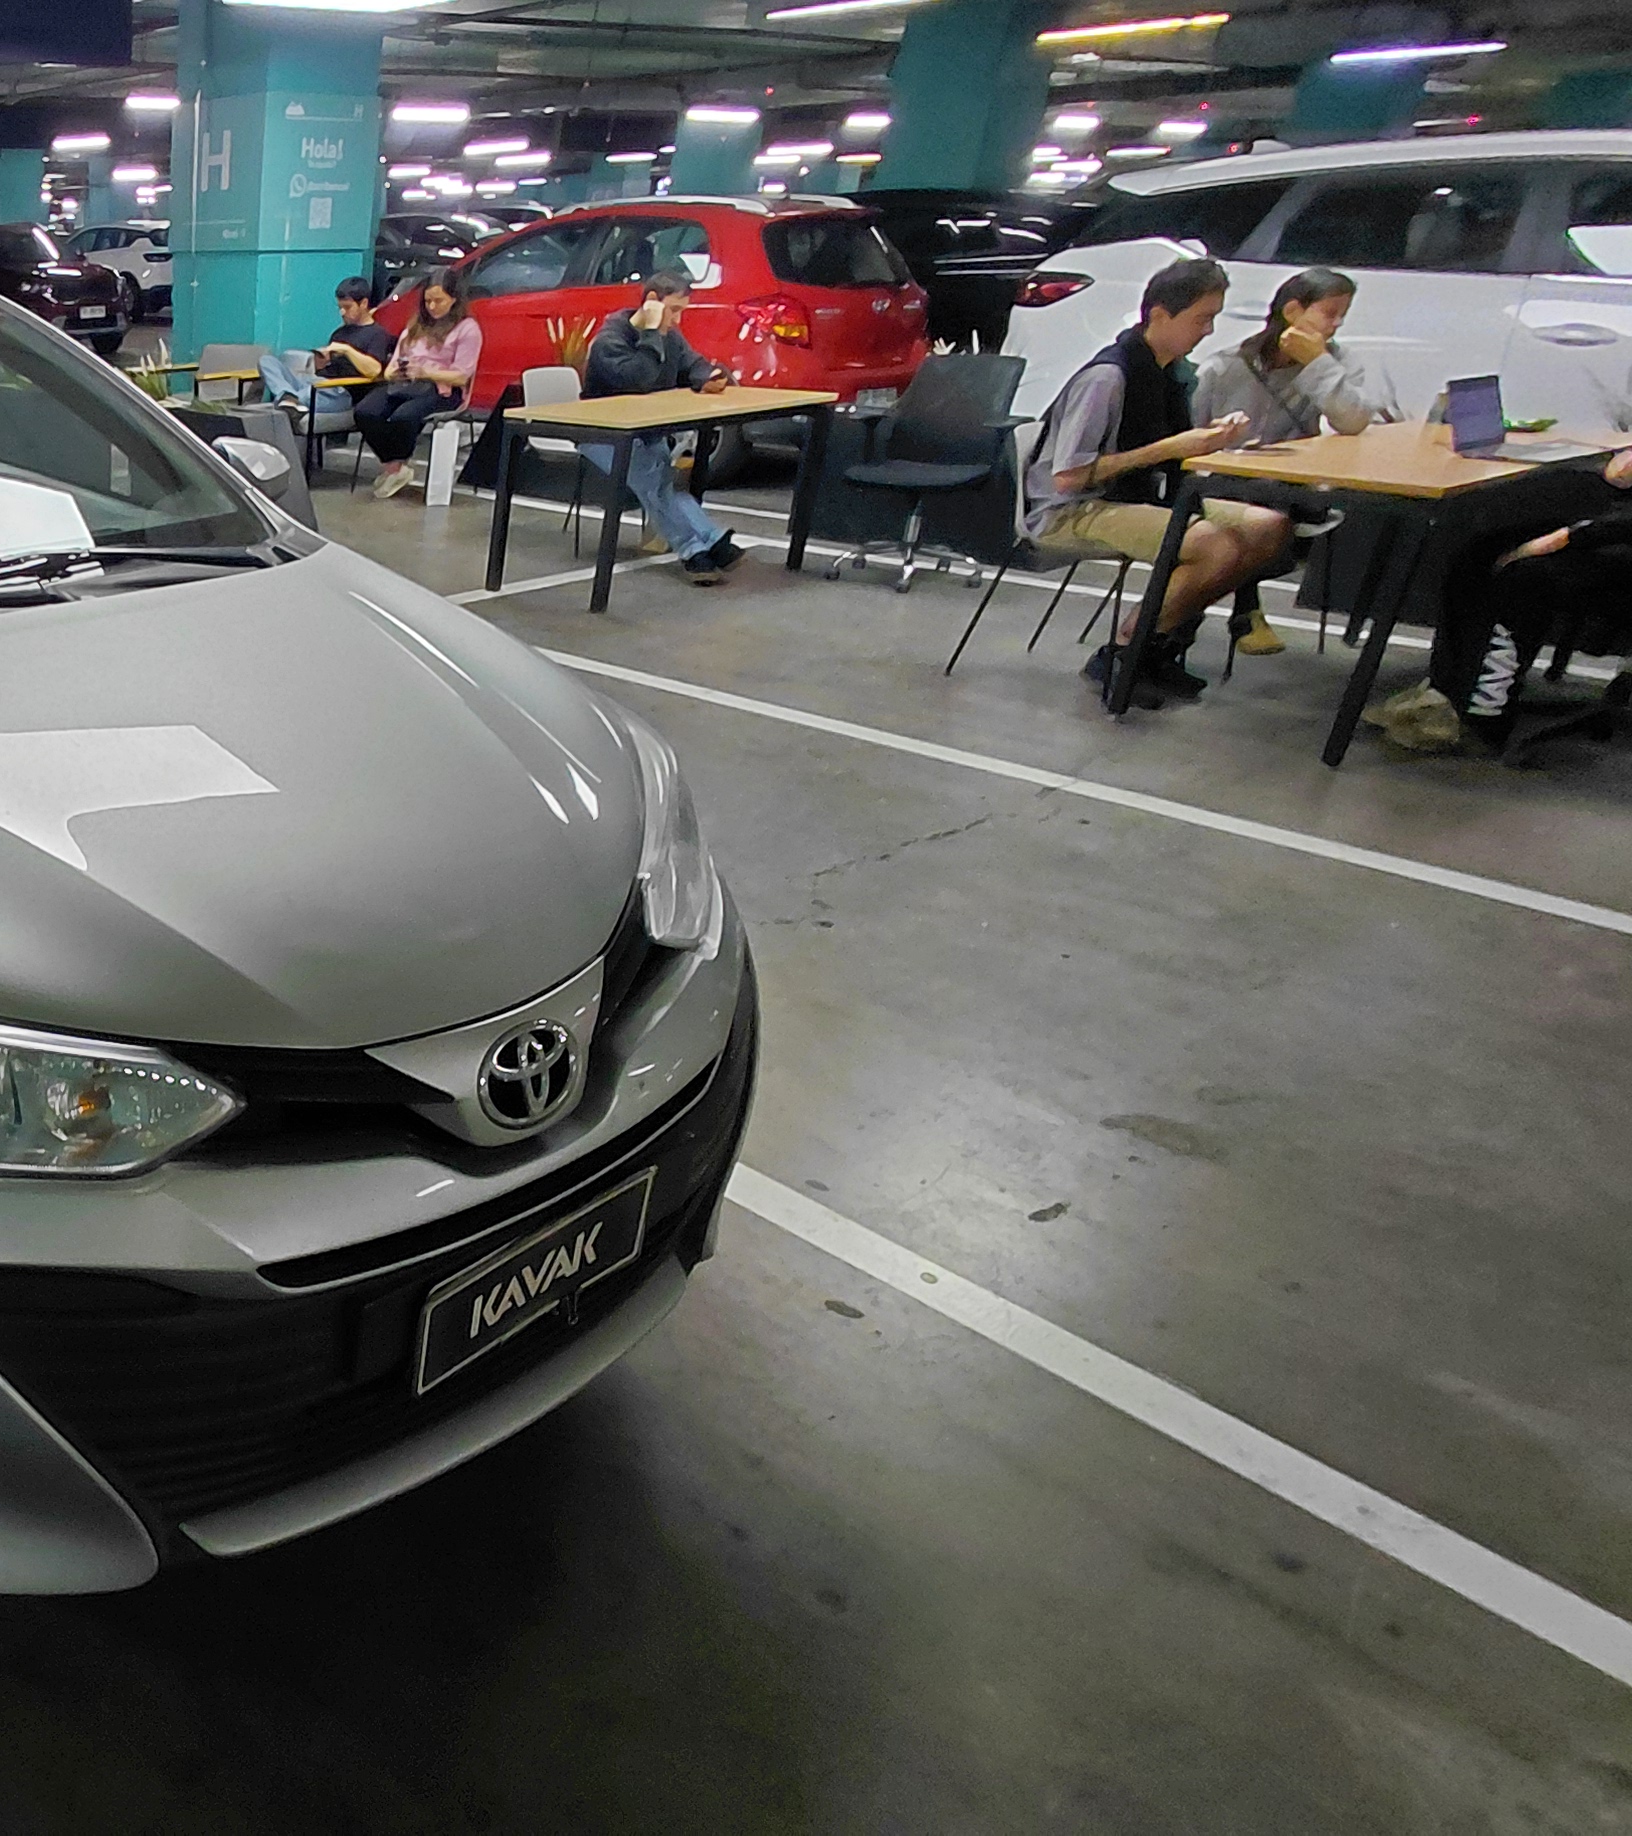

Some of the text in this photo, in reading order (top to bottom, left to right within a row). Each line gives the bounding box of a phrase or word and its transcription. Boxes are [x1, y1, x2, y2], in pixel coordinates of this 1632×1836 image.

[200, 129, 232, 192] H
[300, 136, 345, 161] Hola!
[470, 1221, 604, 1339] KAVAK
